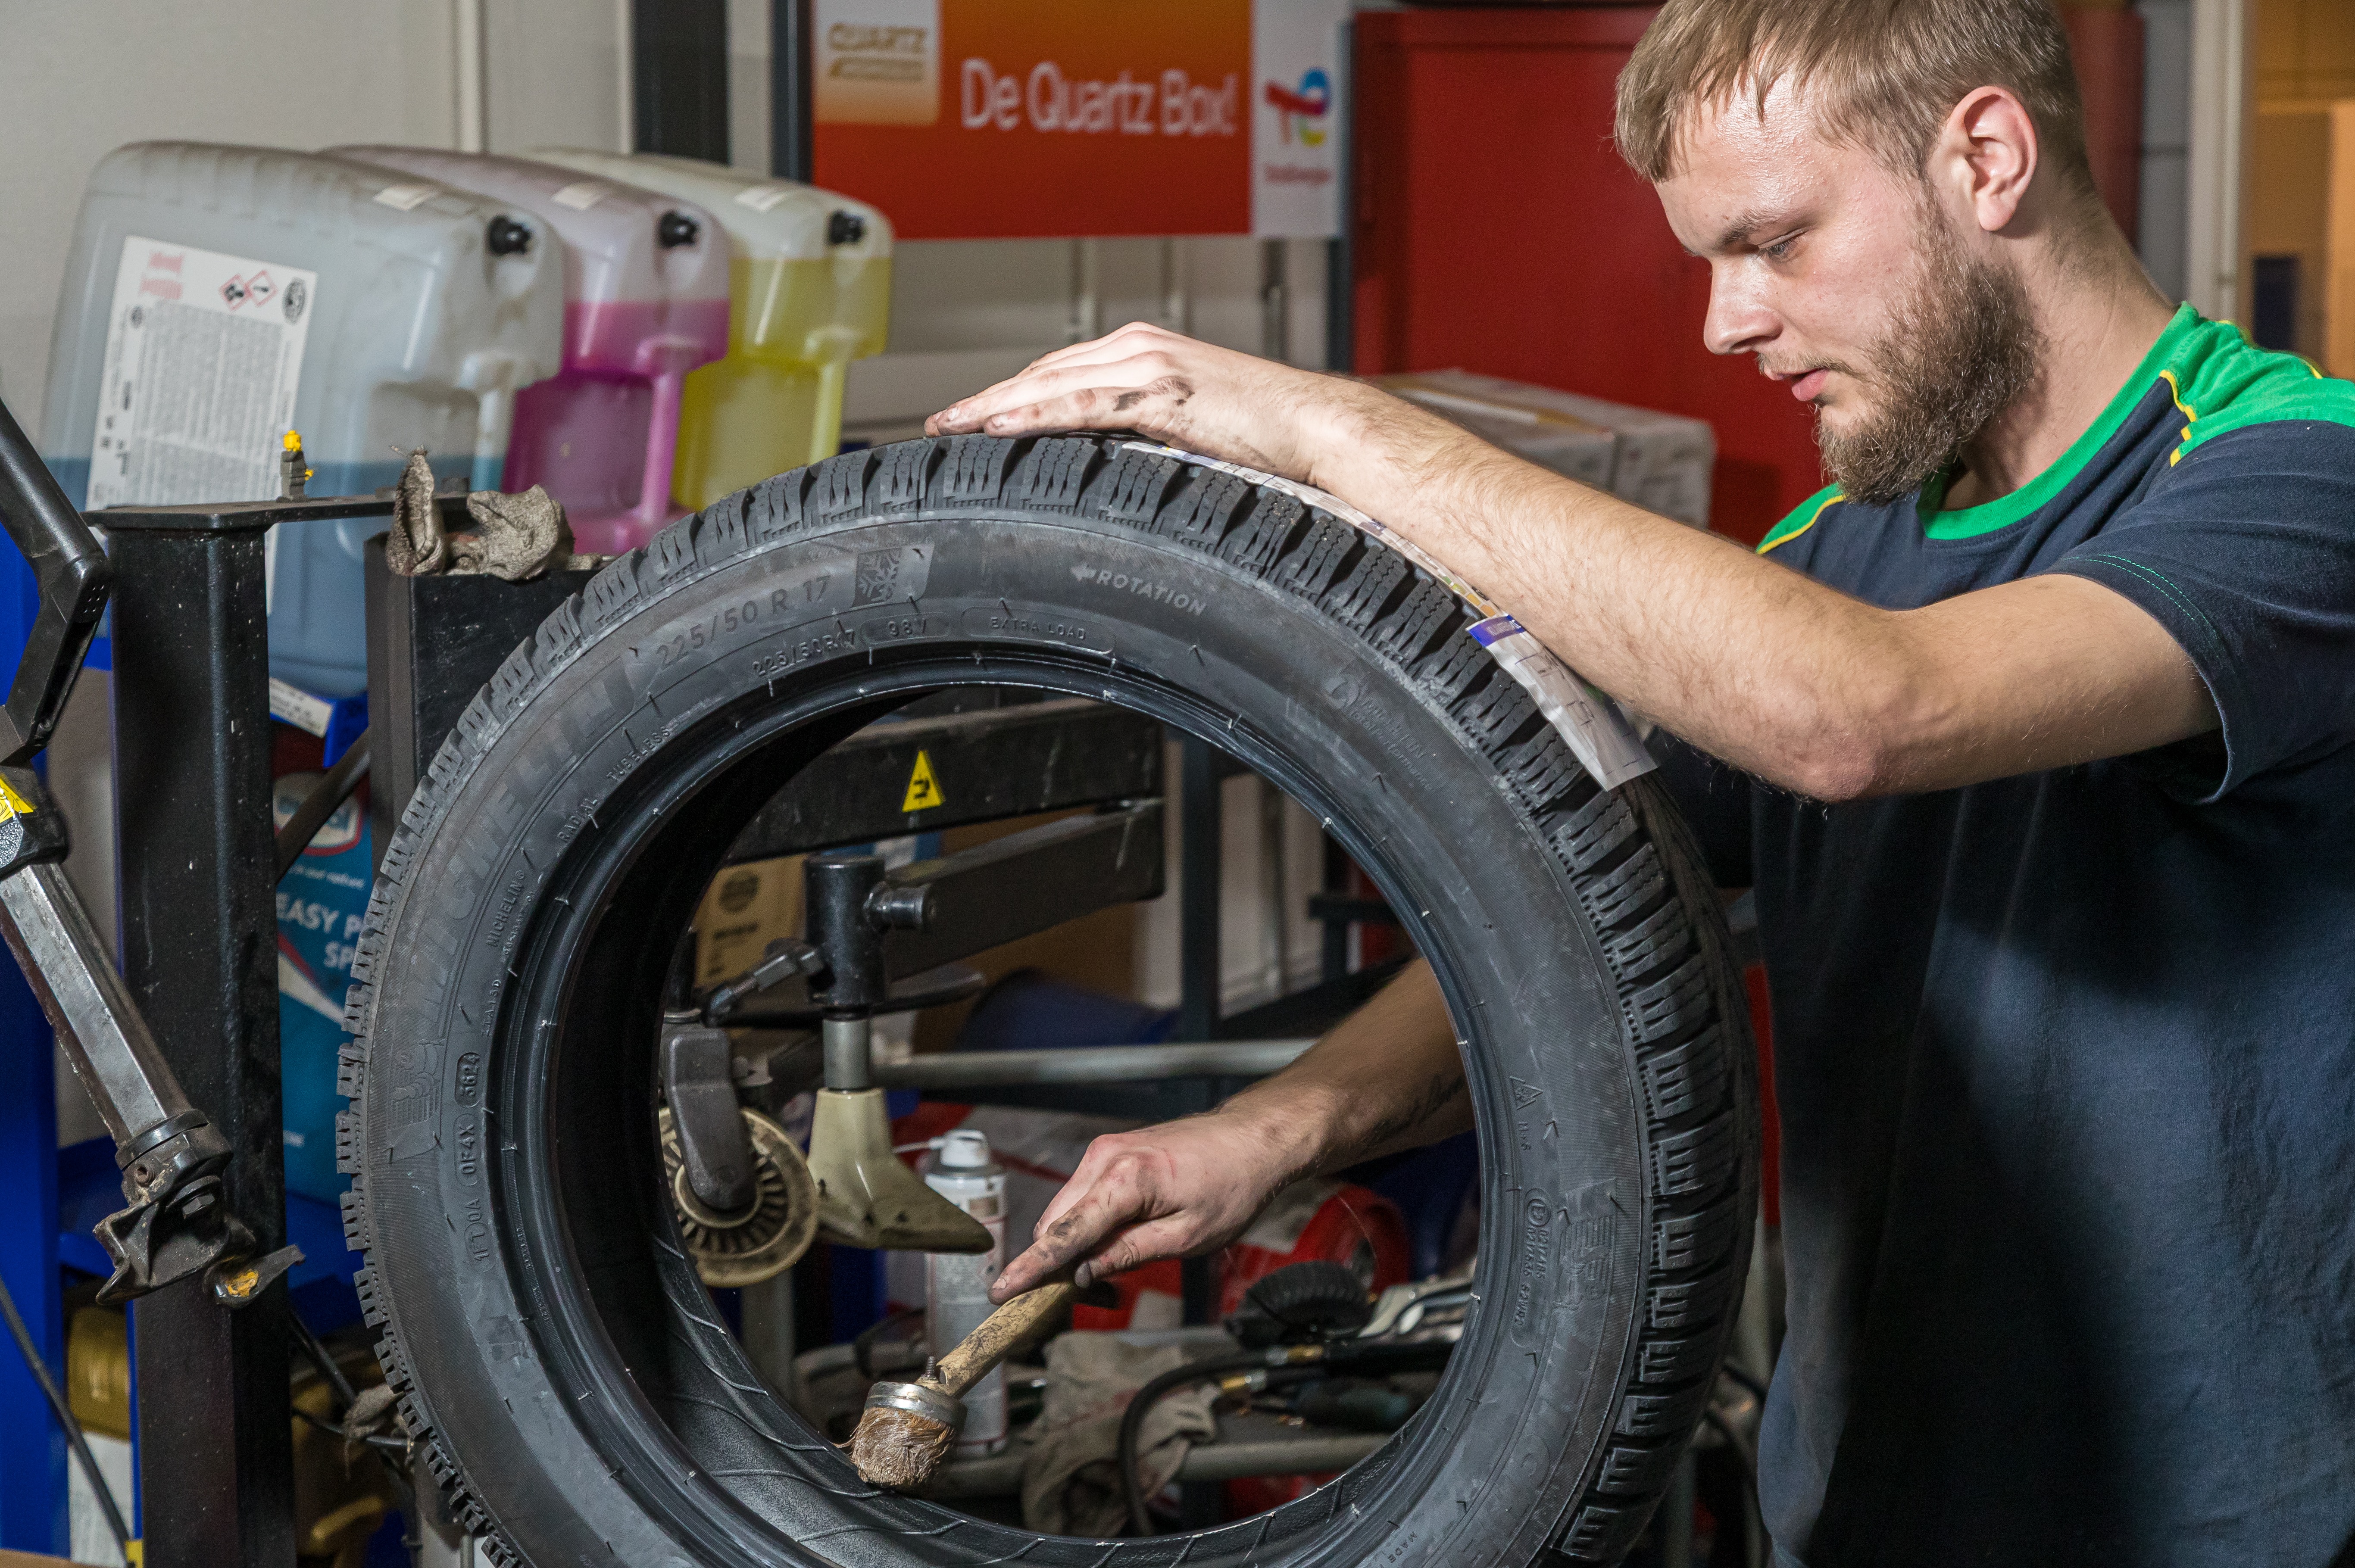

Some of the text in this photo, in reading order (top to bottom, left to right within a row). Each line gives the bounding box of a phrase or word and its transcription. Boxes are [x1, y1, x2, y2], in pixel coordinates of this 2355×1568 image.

[960, 57, 1240, 137] De Quartz Box!
[1097, 569, 1206, 617] ROTATION
[656, 575, 831, 671] 225/50 R 17
[990, 616, 1087, 641] EXTRA LOAD
[751, 629, 856, 678] 225/50R17
[605, 725, 670, 783] TUBELESS
[556, 798, 599, 843] RADIAL
[276, 892, 340, 934] EASY
[324, 940, 359, 969] SP
[1387, 1531, 1418, 1564] MADE
